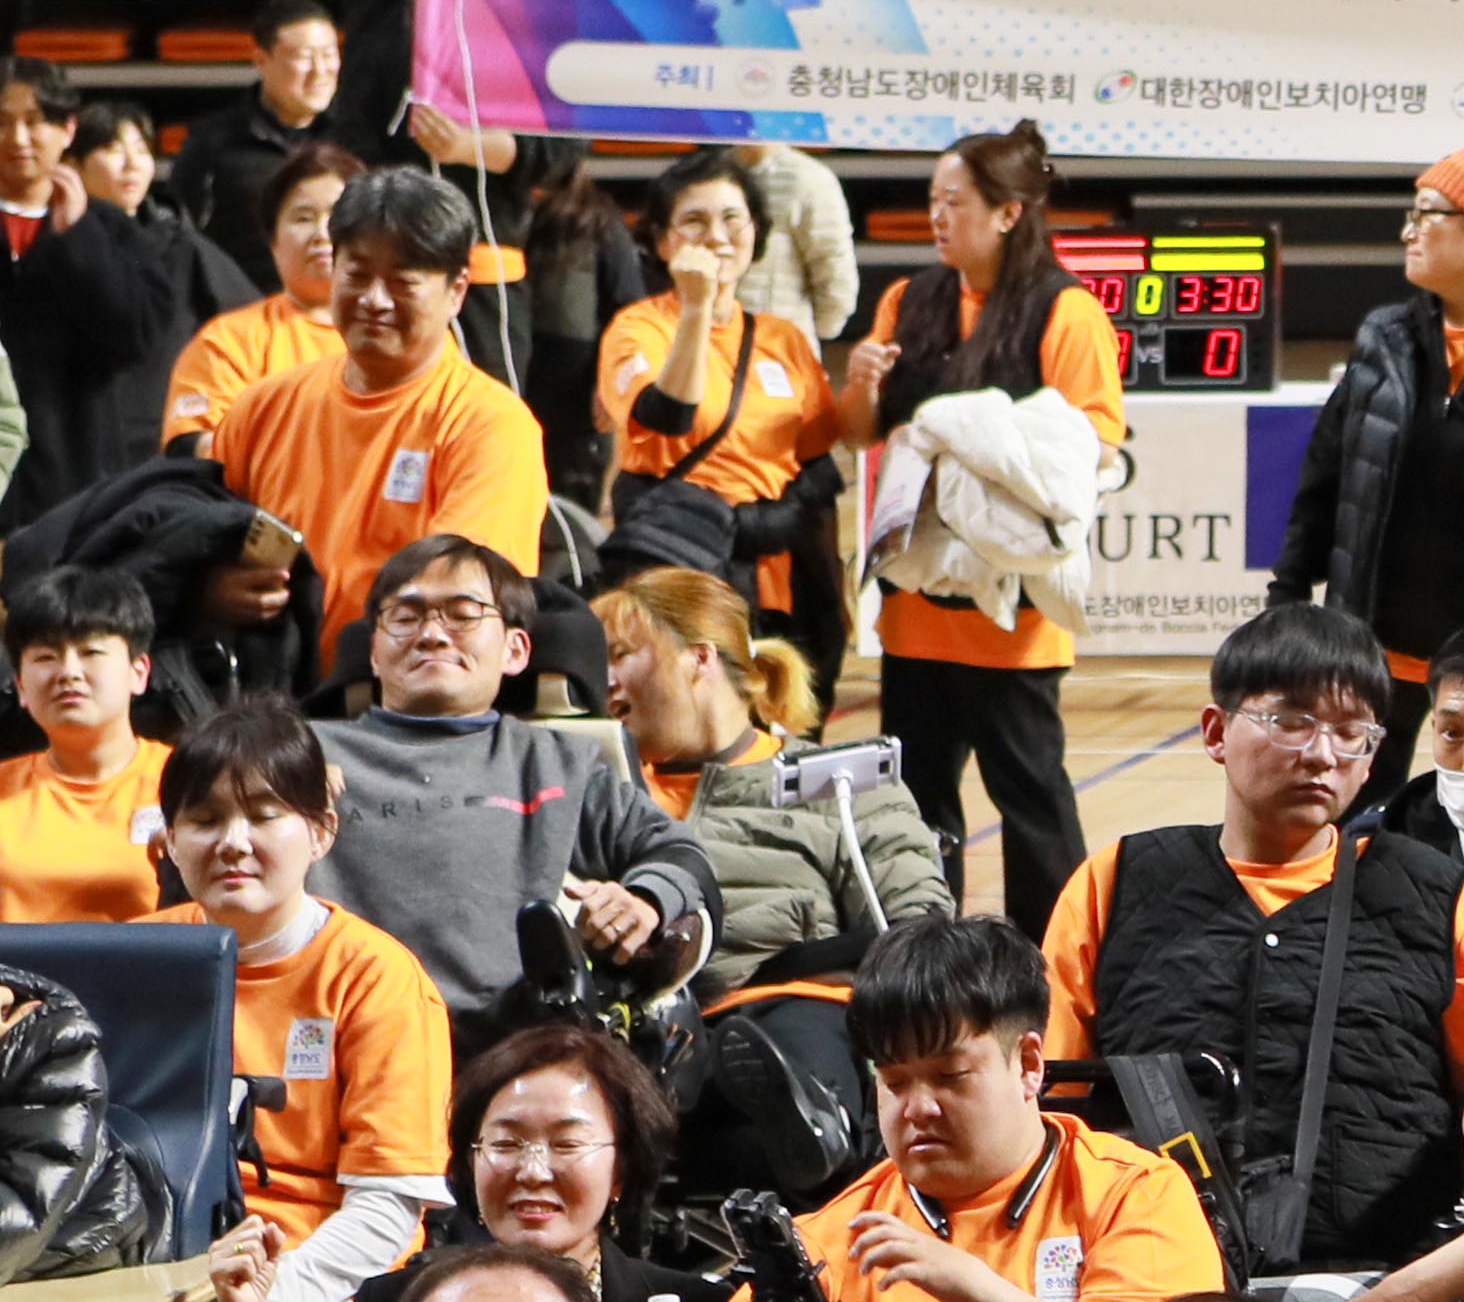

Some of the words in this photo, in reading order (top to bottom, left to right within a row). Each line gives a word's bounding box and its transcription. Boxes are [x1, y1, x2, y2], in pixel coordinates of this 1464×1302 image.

[655, 64, 700, 89] 주최
[788, 64, 1076, 104] 충청남도장애인체육회
[1140, 77, 1428, 116] 대한장애인보치아연맹
[1136, 274, 1164, 315] 0
[1176, 275, 1263, 314] 3:30
[1202, 327, 1242, 378] 0
[1094, 514, 1233, 564] URT
